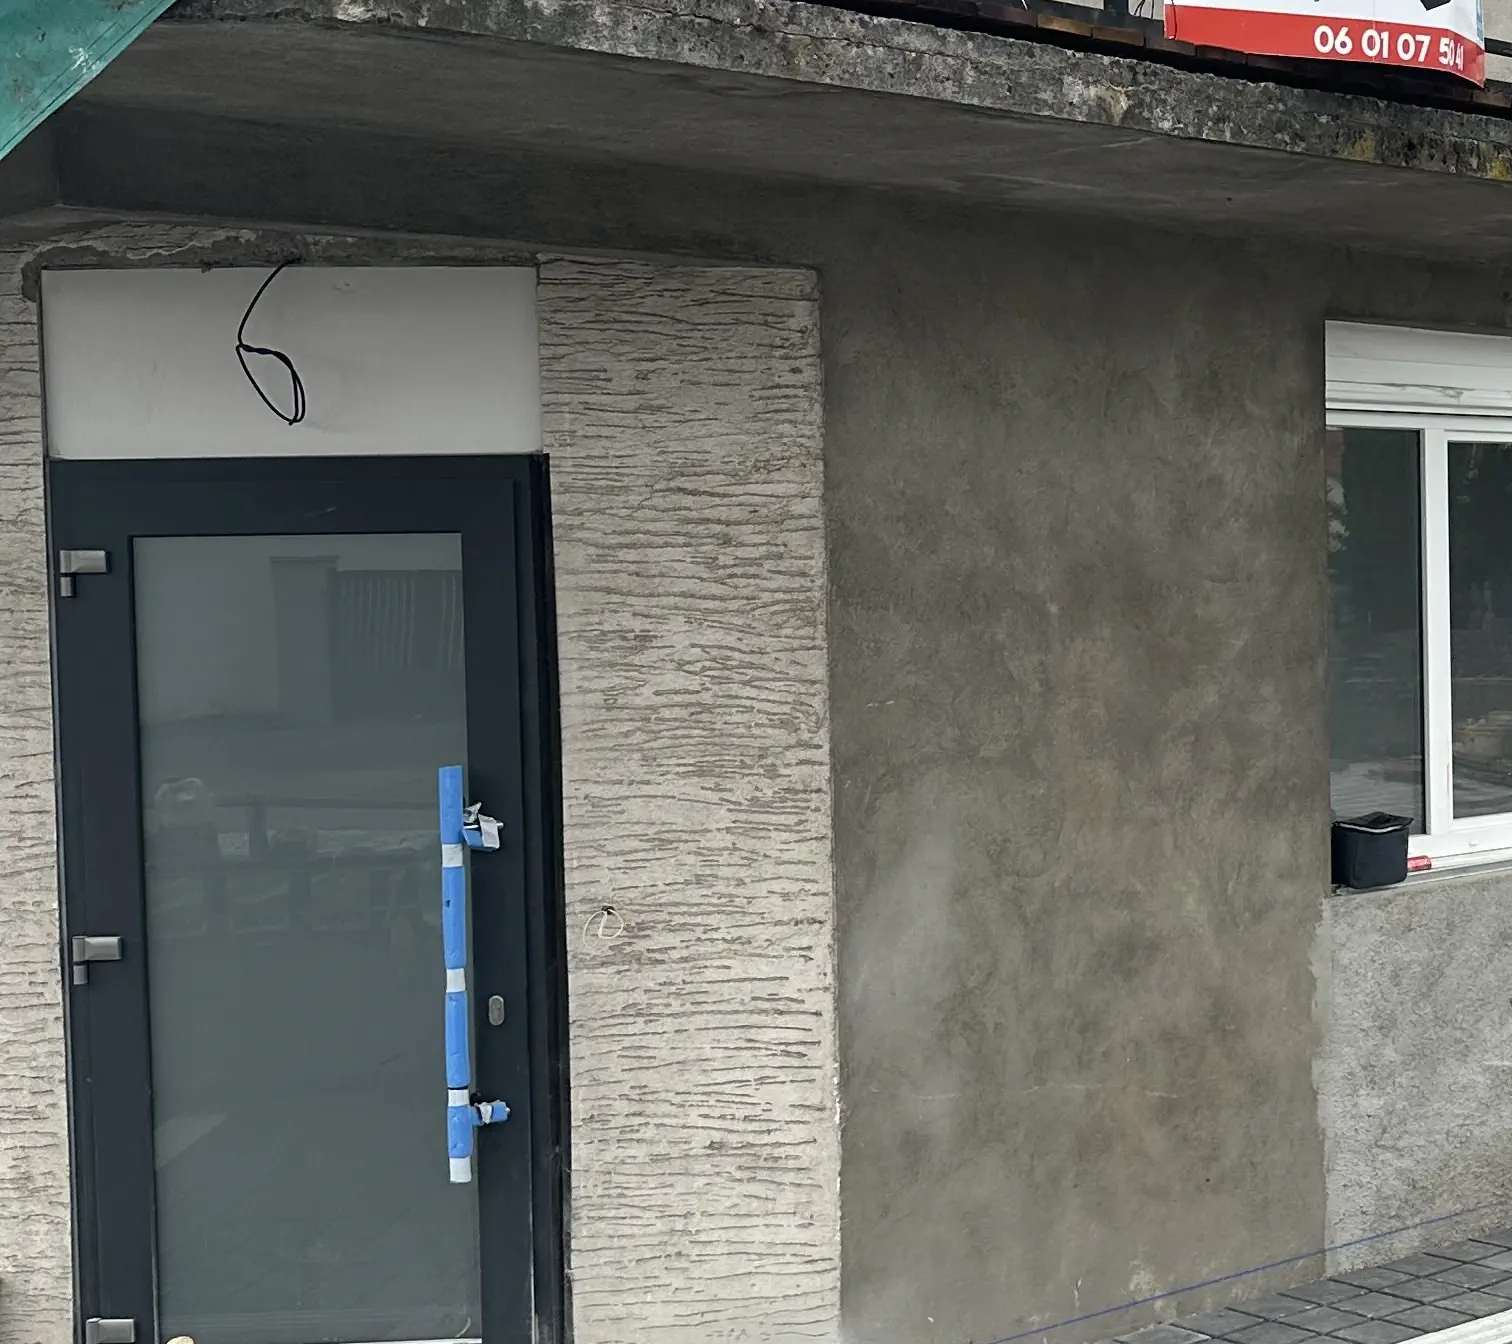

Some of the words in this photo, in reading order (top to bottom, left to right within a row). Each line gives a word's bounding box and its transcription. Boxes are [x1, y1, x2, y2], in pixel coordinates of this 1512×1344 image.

[1314, 24, 1353, 55] 06
[1361, 28, 1390, 59] 01
[1396, 32, 1431, 63] 07
[1439, 37, 1455, 67] 50
